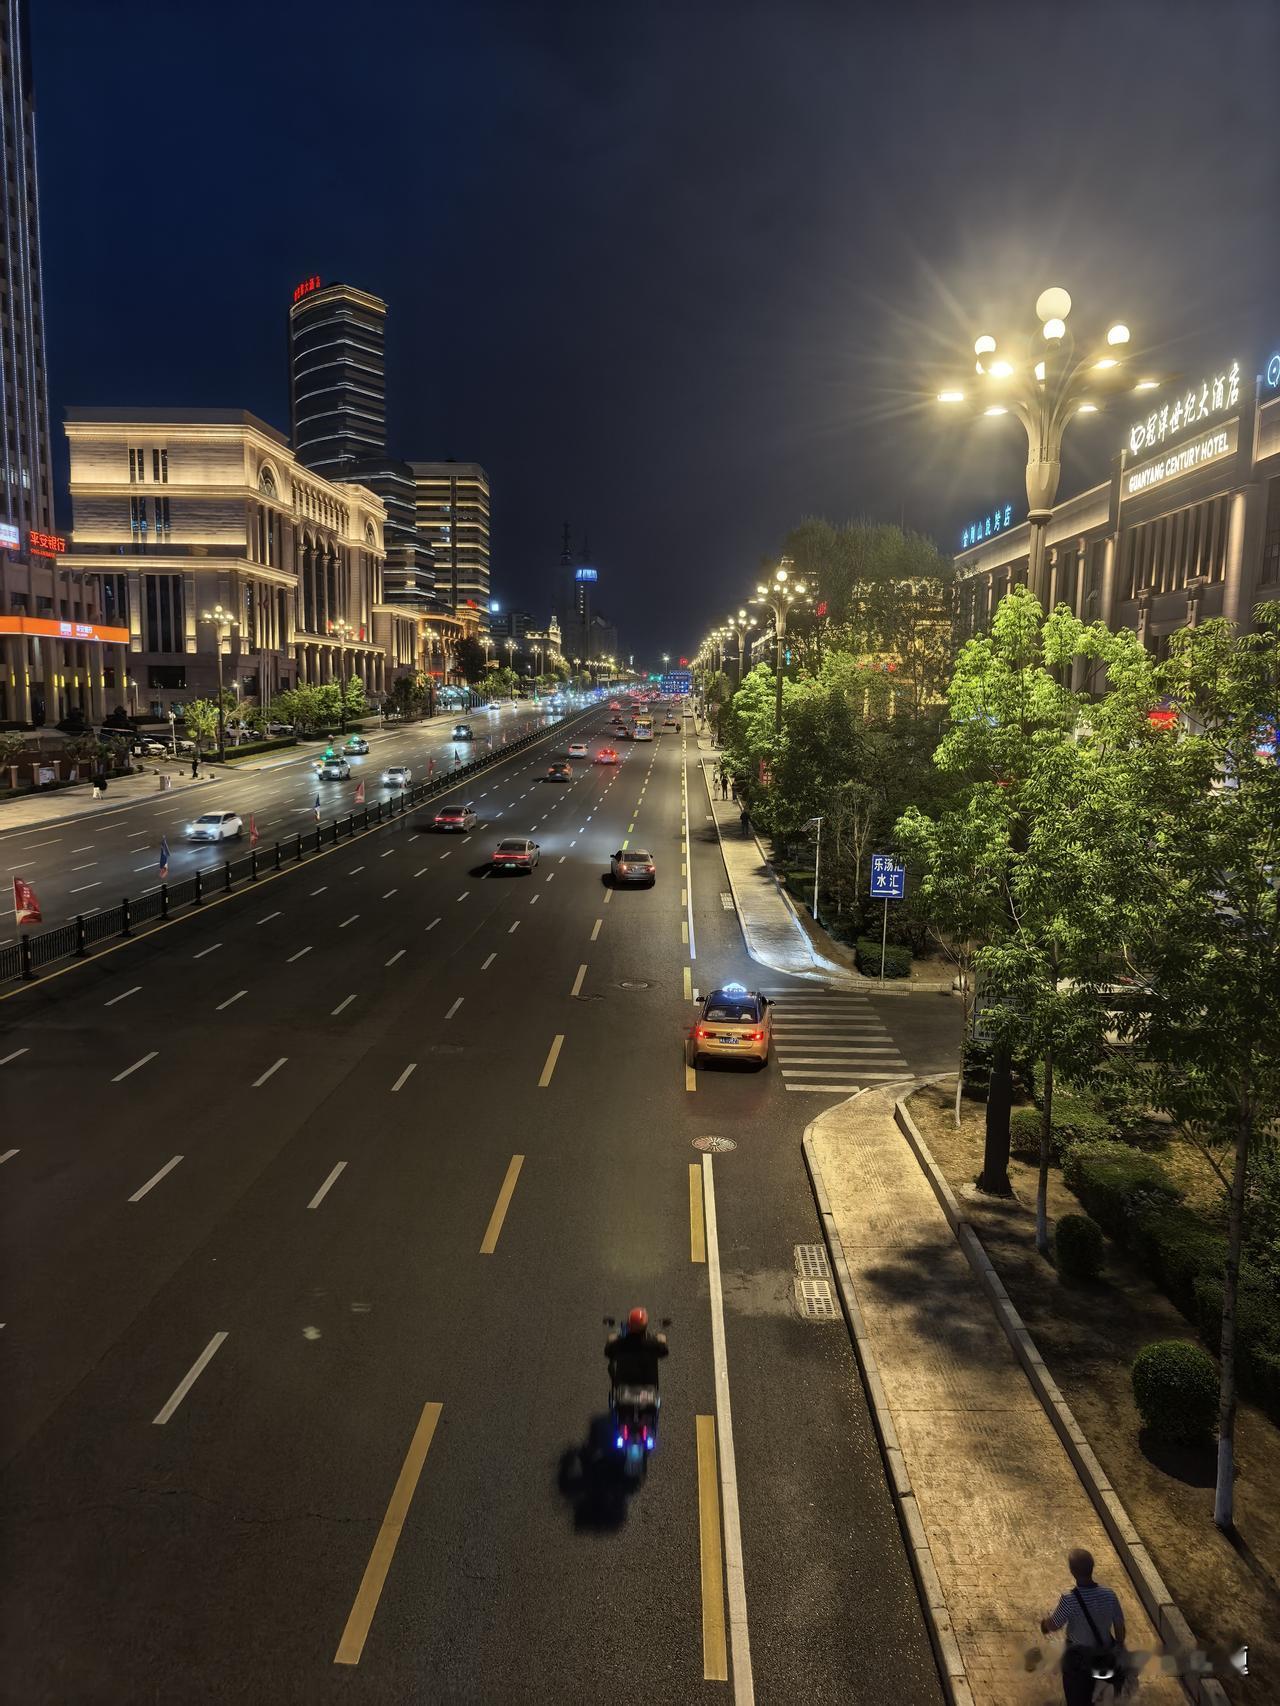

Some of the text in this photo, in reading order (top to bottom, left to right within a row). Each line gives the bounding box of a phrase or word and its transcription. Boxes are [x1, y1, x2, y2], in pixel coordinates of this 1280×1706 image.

[1128, 431, 1229, 493] GUANYANG CENTURY HOTEL
[30, 531, 65, 553] 平安银行
[876, 873, 899, 888] 水汇
